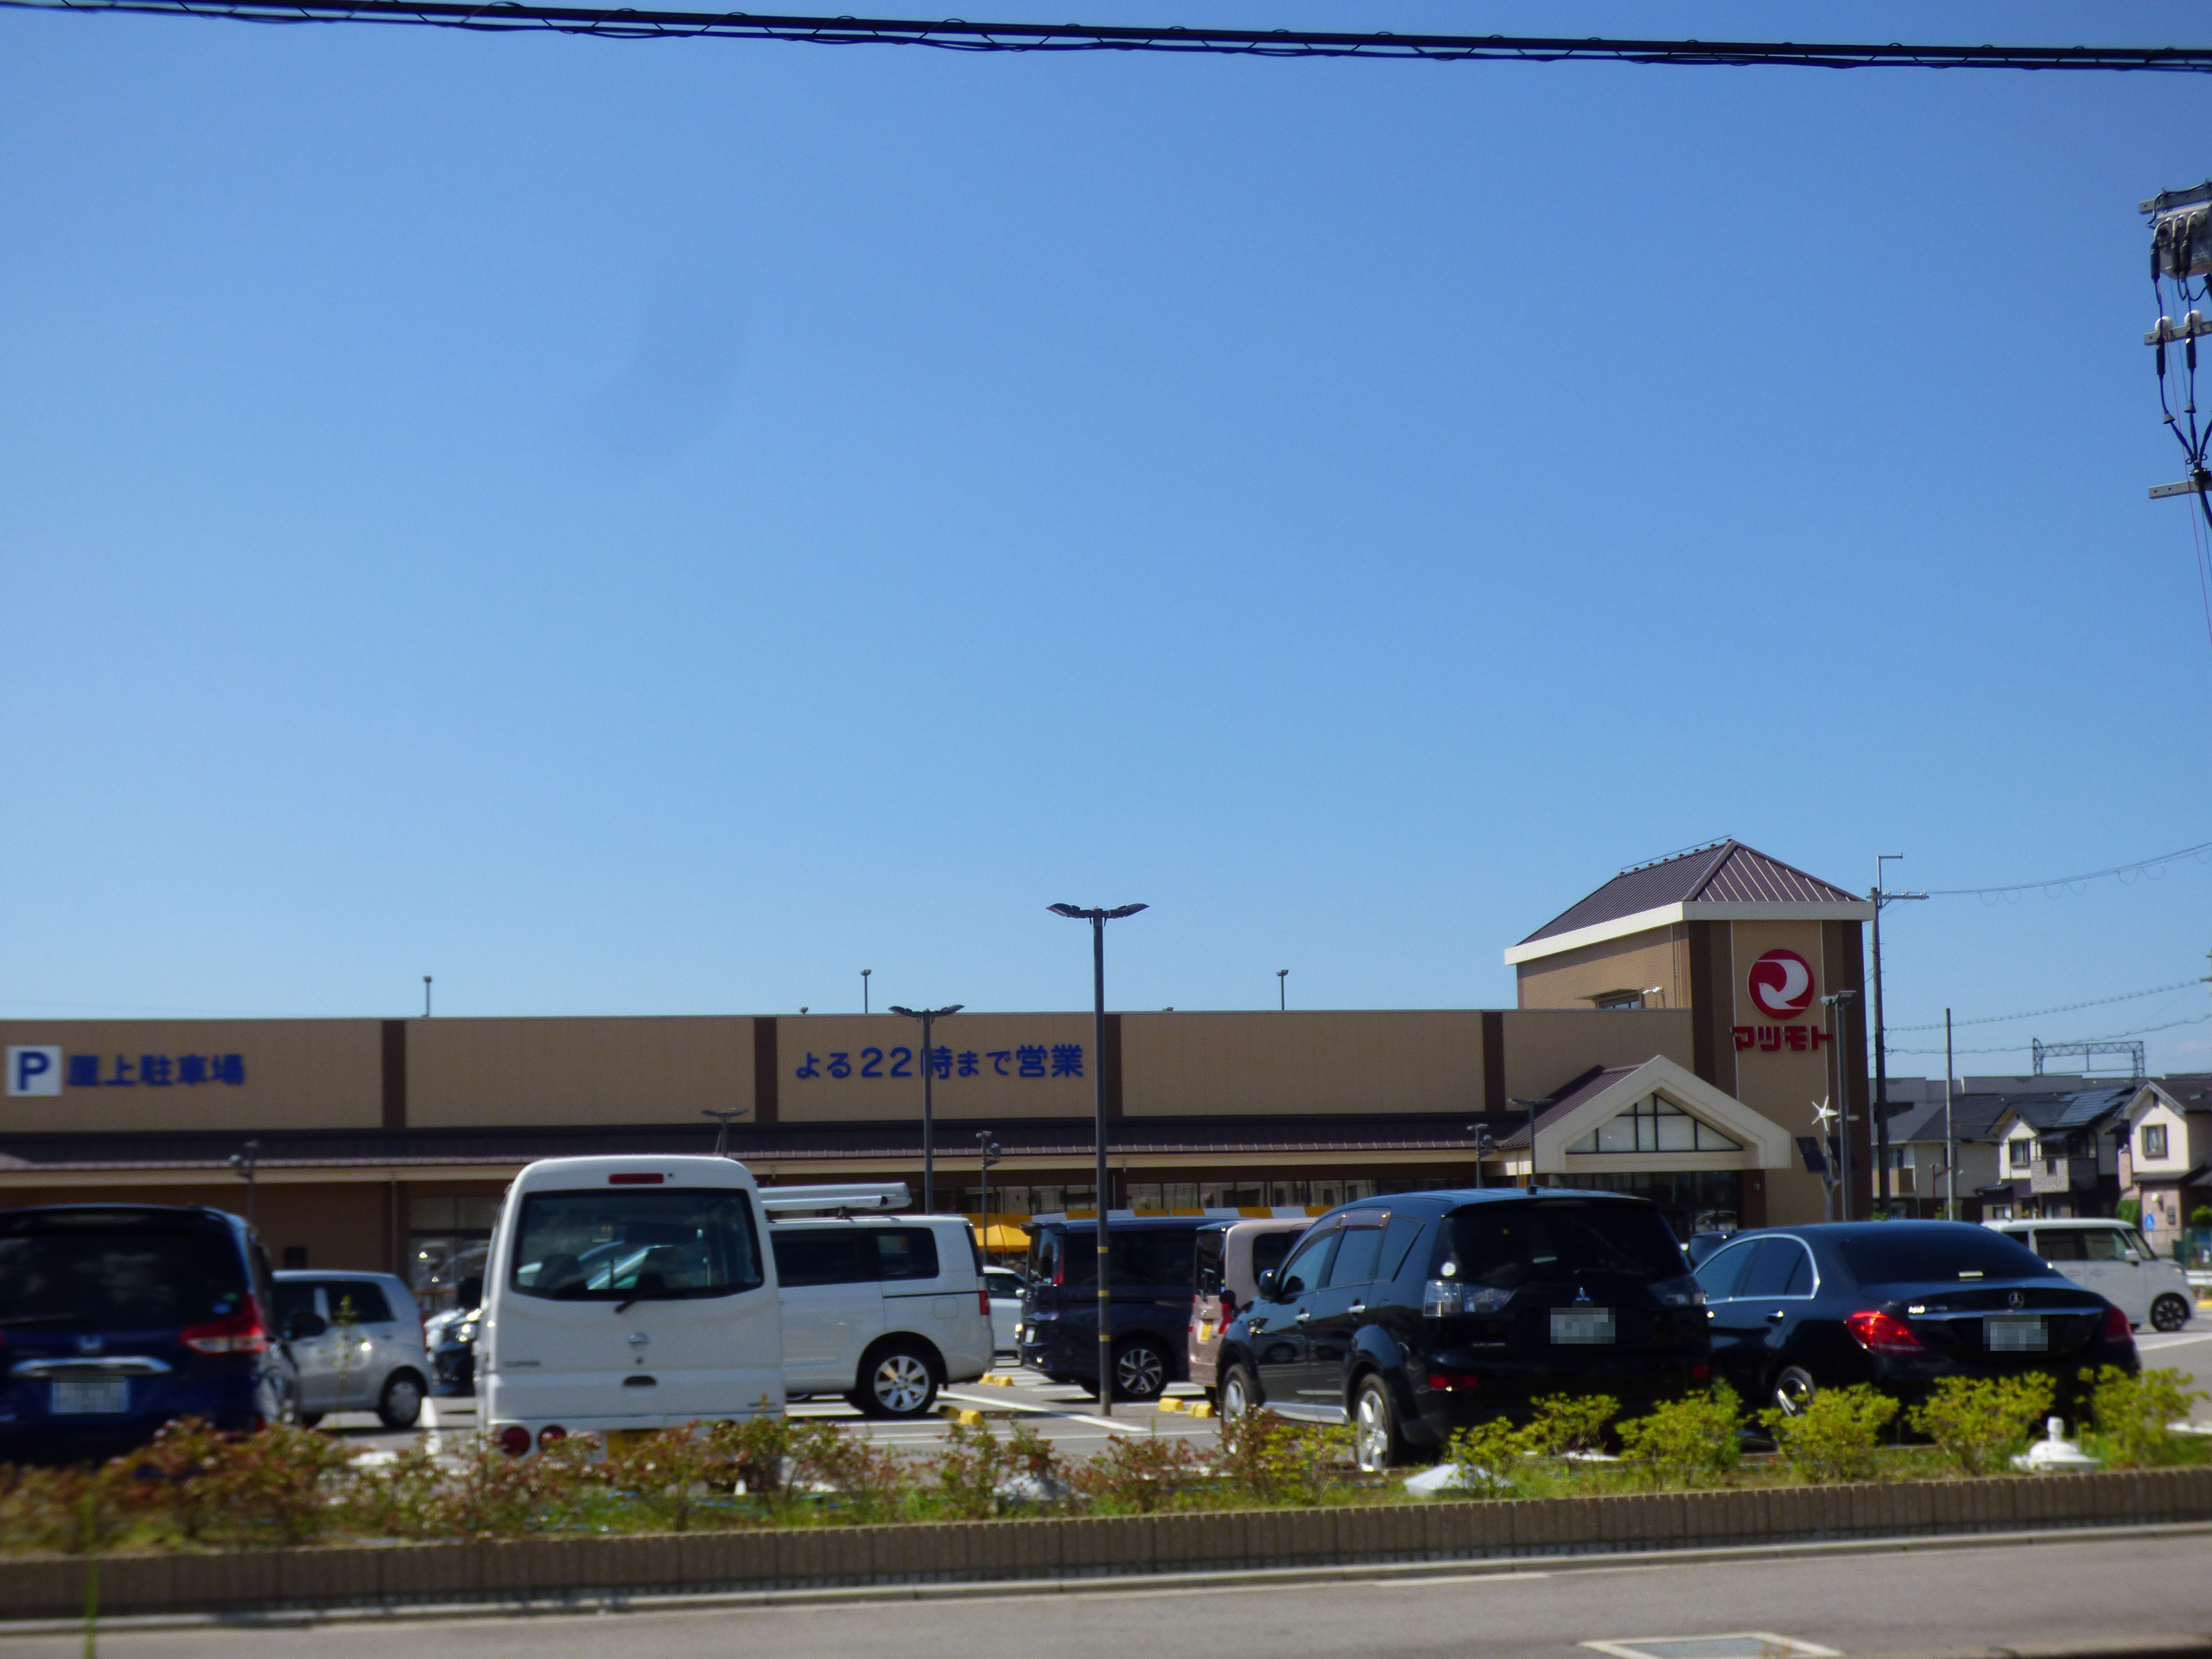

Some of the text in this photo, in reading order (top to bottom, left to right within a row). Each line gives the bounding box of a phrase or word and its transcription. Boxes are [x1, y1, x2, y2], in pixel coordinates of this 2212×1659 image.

[1731, 1026, 1834, 1051] マツモト
[18, 1051, 50, 1091] P
[796, 1044, 1083, 1079] よる22時まで営業
